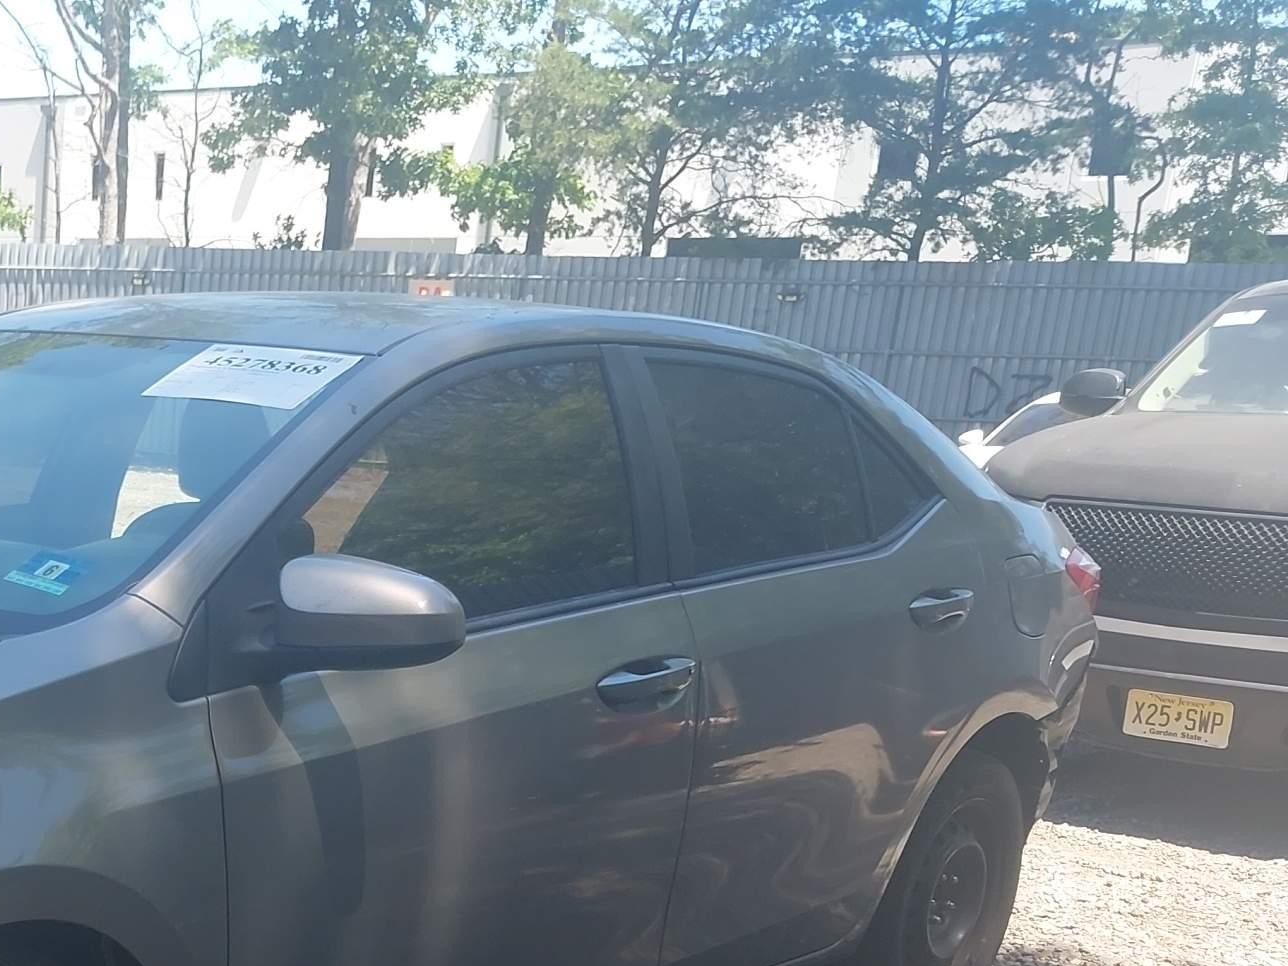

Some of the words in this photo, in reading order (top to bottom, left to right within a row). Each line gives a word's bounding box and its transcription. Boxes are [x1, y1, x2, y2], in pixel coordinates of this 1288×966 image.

[205, 356, 328, 375] 45278368
[1154, 695, 1175, 705] New
[1149, 727, 1178, 738] Garden
[1180, 731, 1202, 741] State
